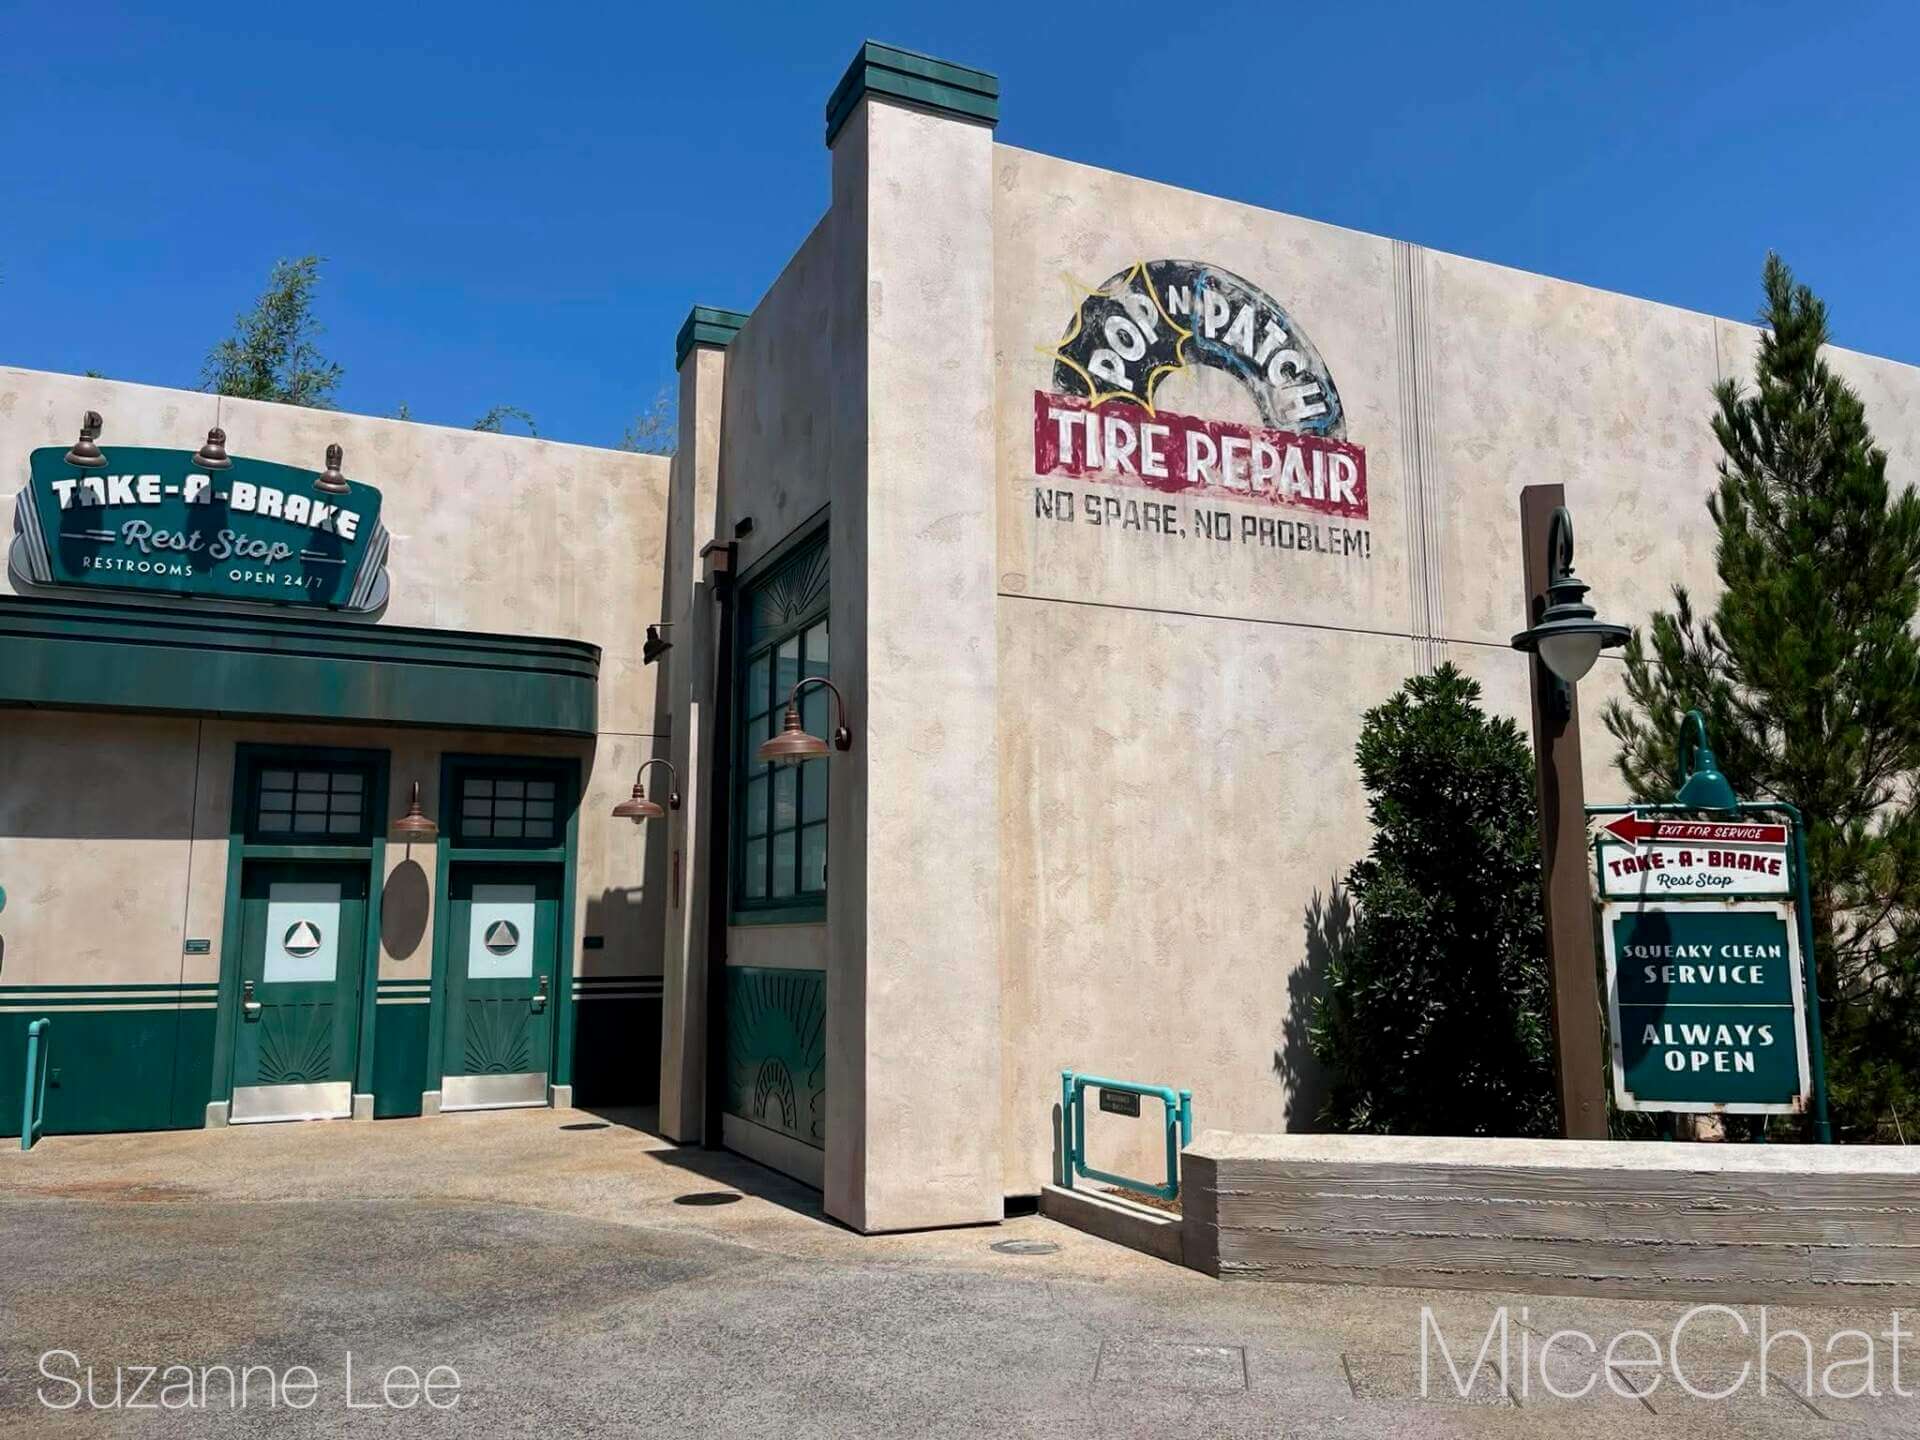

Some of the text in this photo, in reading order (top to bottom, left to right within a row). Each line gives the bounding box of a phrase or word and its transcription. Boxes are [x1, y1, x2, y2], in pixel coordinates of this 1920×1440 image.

[1087, 284, 1328, 423] POP N PATCH
[1049, 406, 1359, 506] TIRE REPAIR
[52, 473, 361, 541] TAKE-A-BRAKE
[1035, 487, 1371, 559] NO SPARE, NO PROBLEM!
[121, 519, 293, 565] Rest Stop
[83, 556, 194, 578] RESTROOMS
[229, 569, 323, 589] OPEN 24/7
[1657, 824, 1764, 840] EXIT FOR SERVICE
[1656, 872, 1734, 889] Rest Stop
[1623, 944, 1782, 959] SQUEAKY CLEAN
[1643, 965, 1764, 985] SERVICE
[1642, 1023, 1775, 1047] ALWAYS
[1664, 1050, 1755, 1073] OPEN
